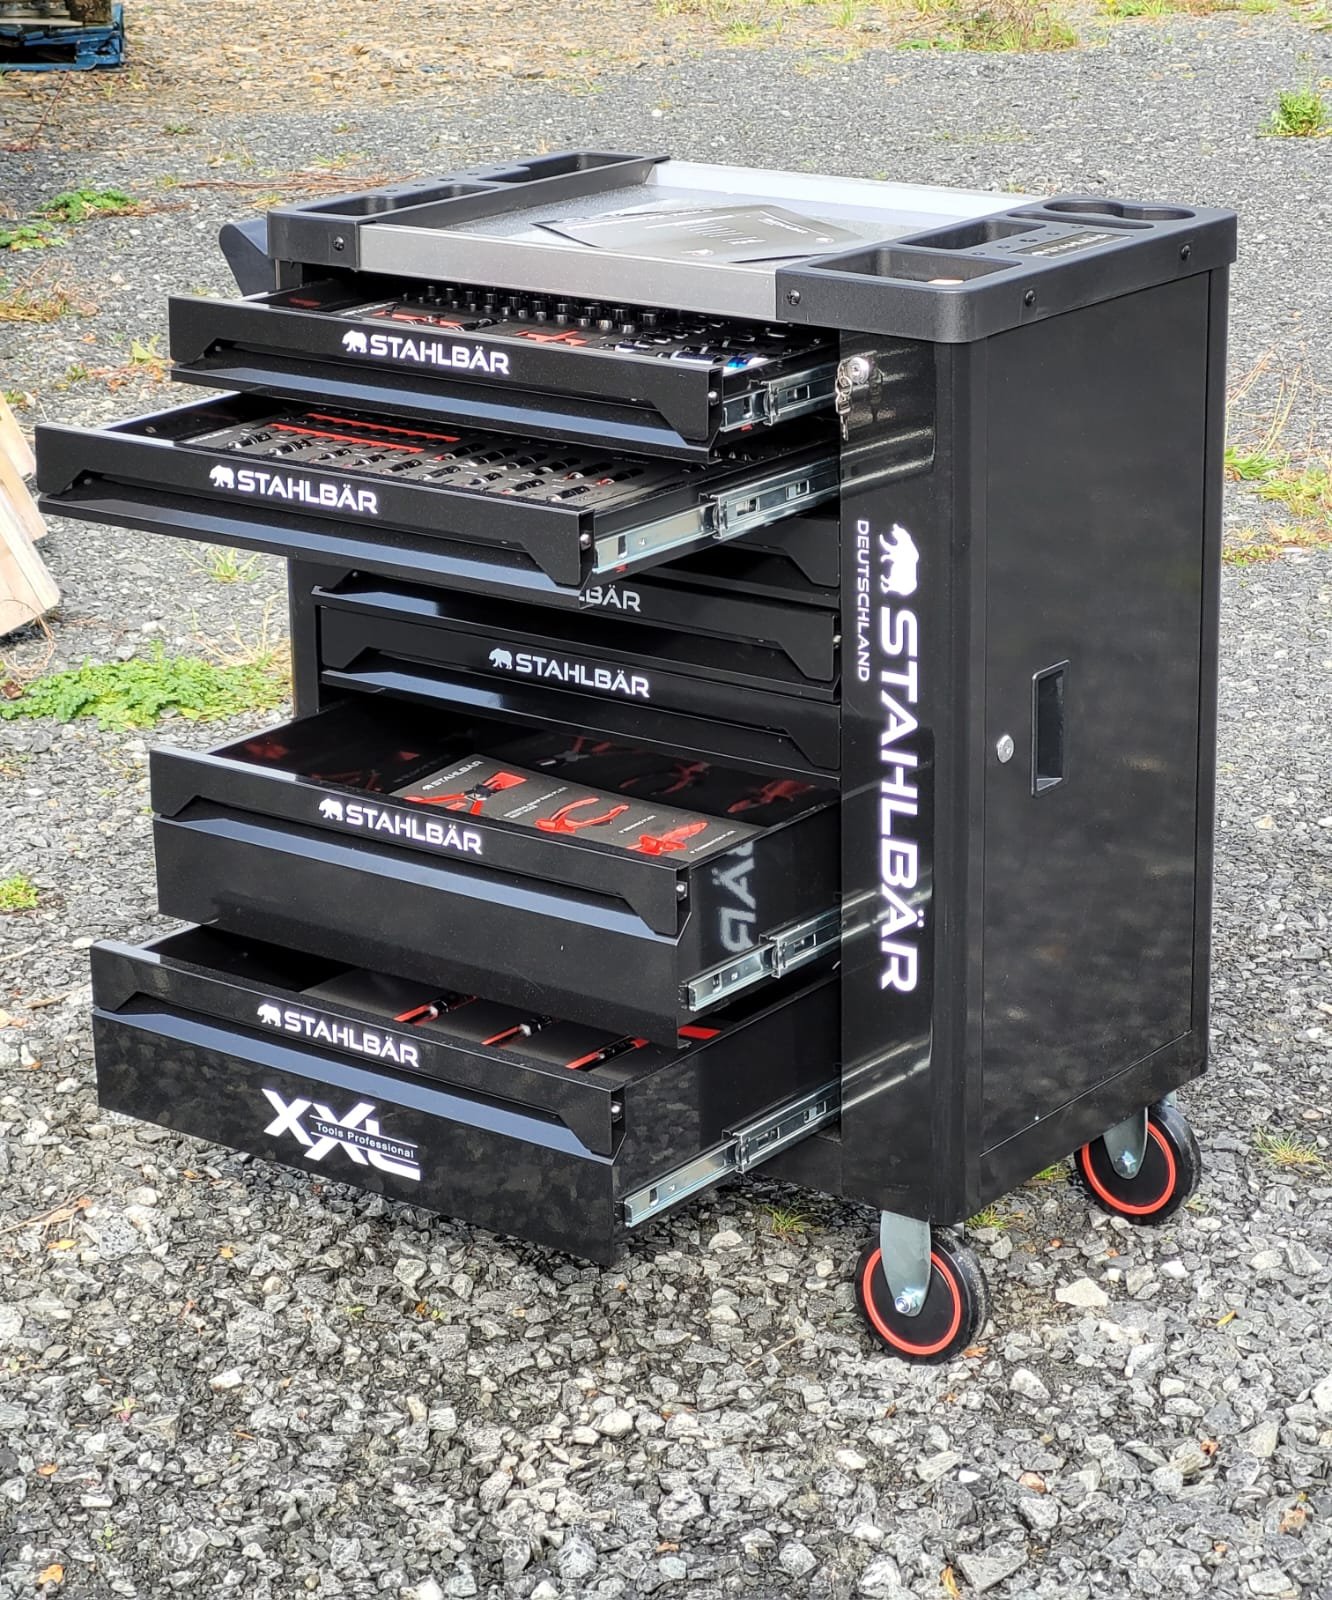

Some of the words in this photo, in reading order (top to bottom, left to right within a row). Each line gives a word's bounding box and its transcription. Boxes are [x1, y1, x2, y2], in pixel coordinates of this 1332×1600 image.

[370, 334, 509, 375] STAHLBÄR
[237, 469, 378, 514] STAHLBÄR
[579, 584, 641, 612] BÄR
[857, 519, 870, 682] DEUTSCHLAND
[515, 653, 650, 698] STAHLBÄR
[881, 606, 924, 992] STAHLBÄR
[346, 804, 483, 855] STAHLBÄR
[284, 1010, 419, 1068] STAHLBÄR
[261, 1088, 421, 1181] XXL
[315, 1121, 344, 1139] Tools
[347, 1131, 415, 1159] Professional
